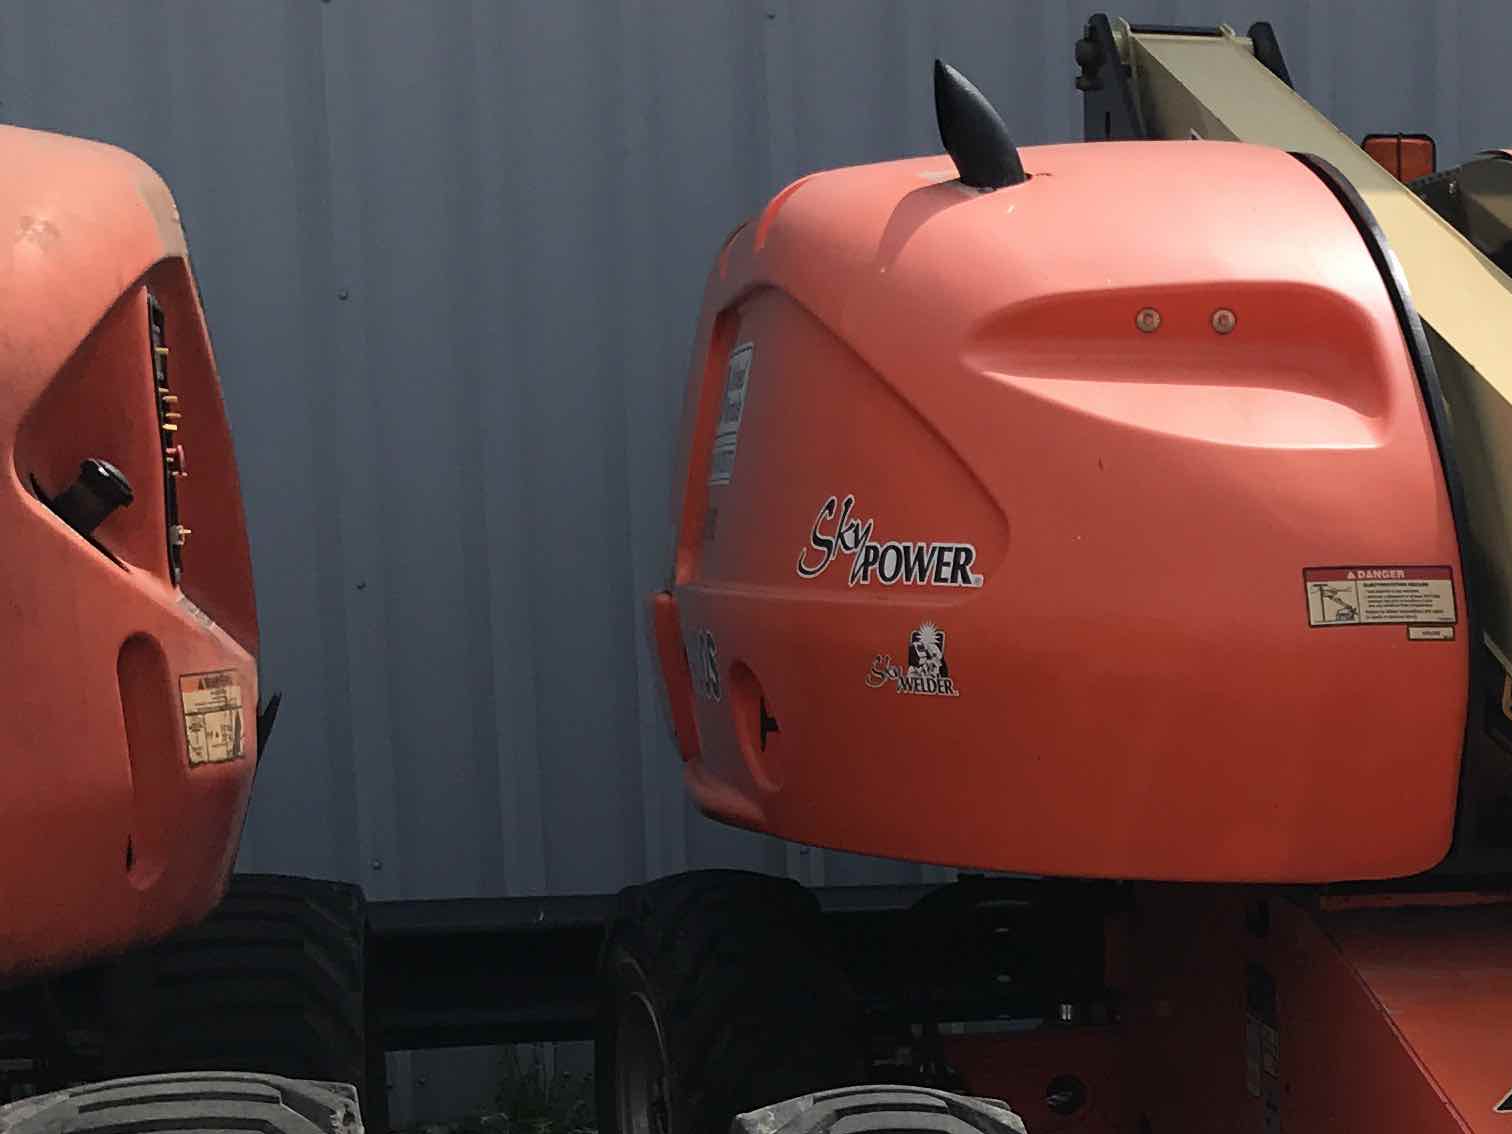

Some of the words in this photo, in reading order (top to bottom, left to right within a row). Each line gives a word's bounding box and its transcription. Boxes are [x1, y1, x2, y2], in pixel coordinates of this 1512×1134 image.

[799, 496, 873, 586] Sky
[861, 543, 973, 585] POWER
[1357, 569, 1406, 579] DANGER
